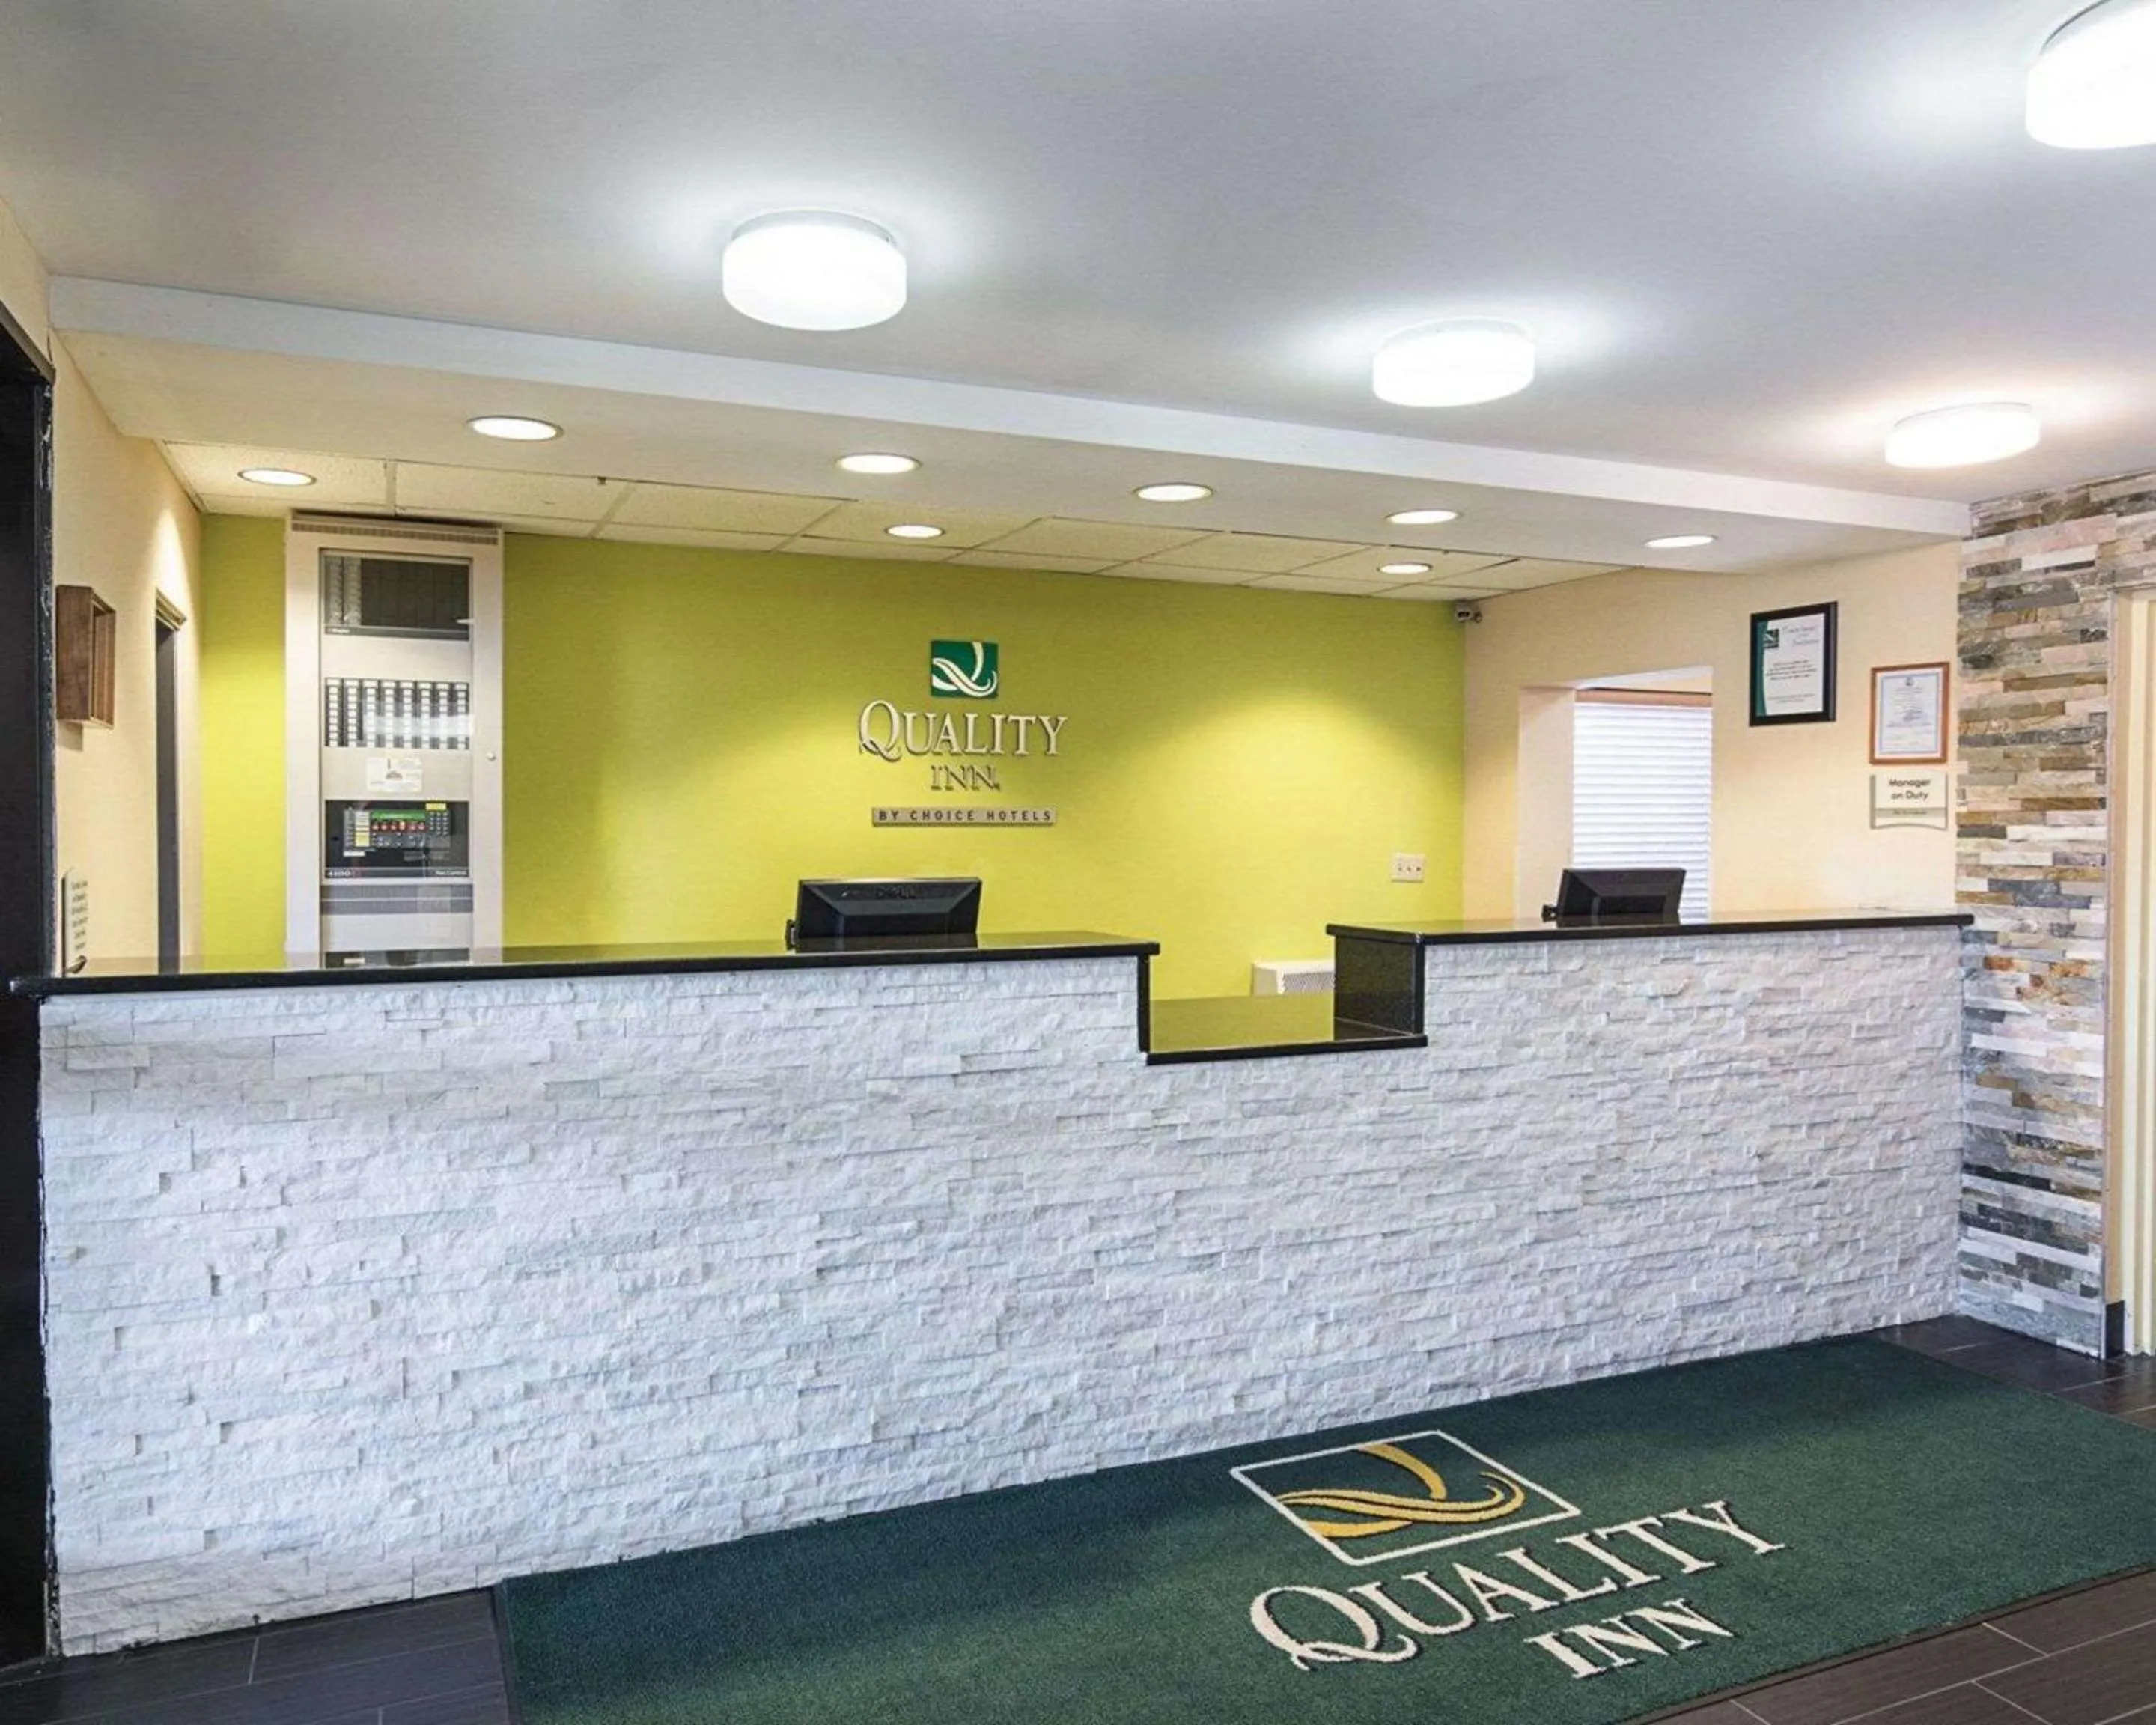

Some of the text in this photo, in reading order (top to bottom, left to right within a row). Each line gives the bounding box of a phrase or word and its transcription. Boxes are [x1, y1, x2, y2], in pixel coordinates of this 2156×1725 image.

[859, 699, 1068, 762] QUALITY
[931, 764, 1001, 791] INN
[1889, 779, 1931, 788] Manager
[1905, 790, 1928, 802] Duty
[877, 810, 1052, 821] BY CHOICE HOTELS
[1249, 1500, 1786, 1671] QUALITY
[1523, 1597, 1735, 1679] INN
